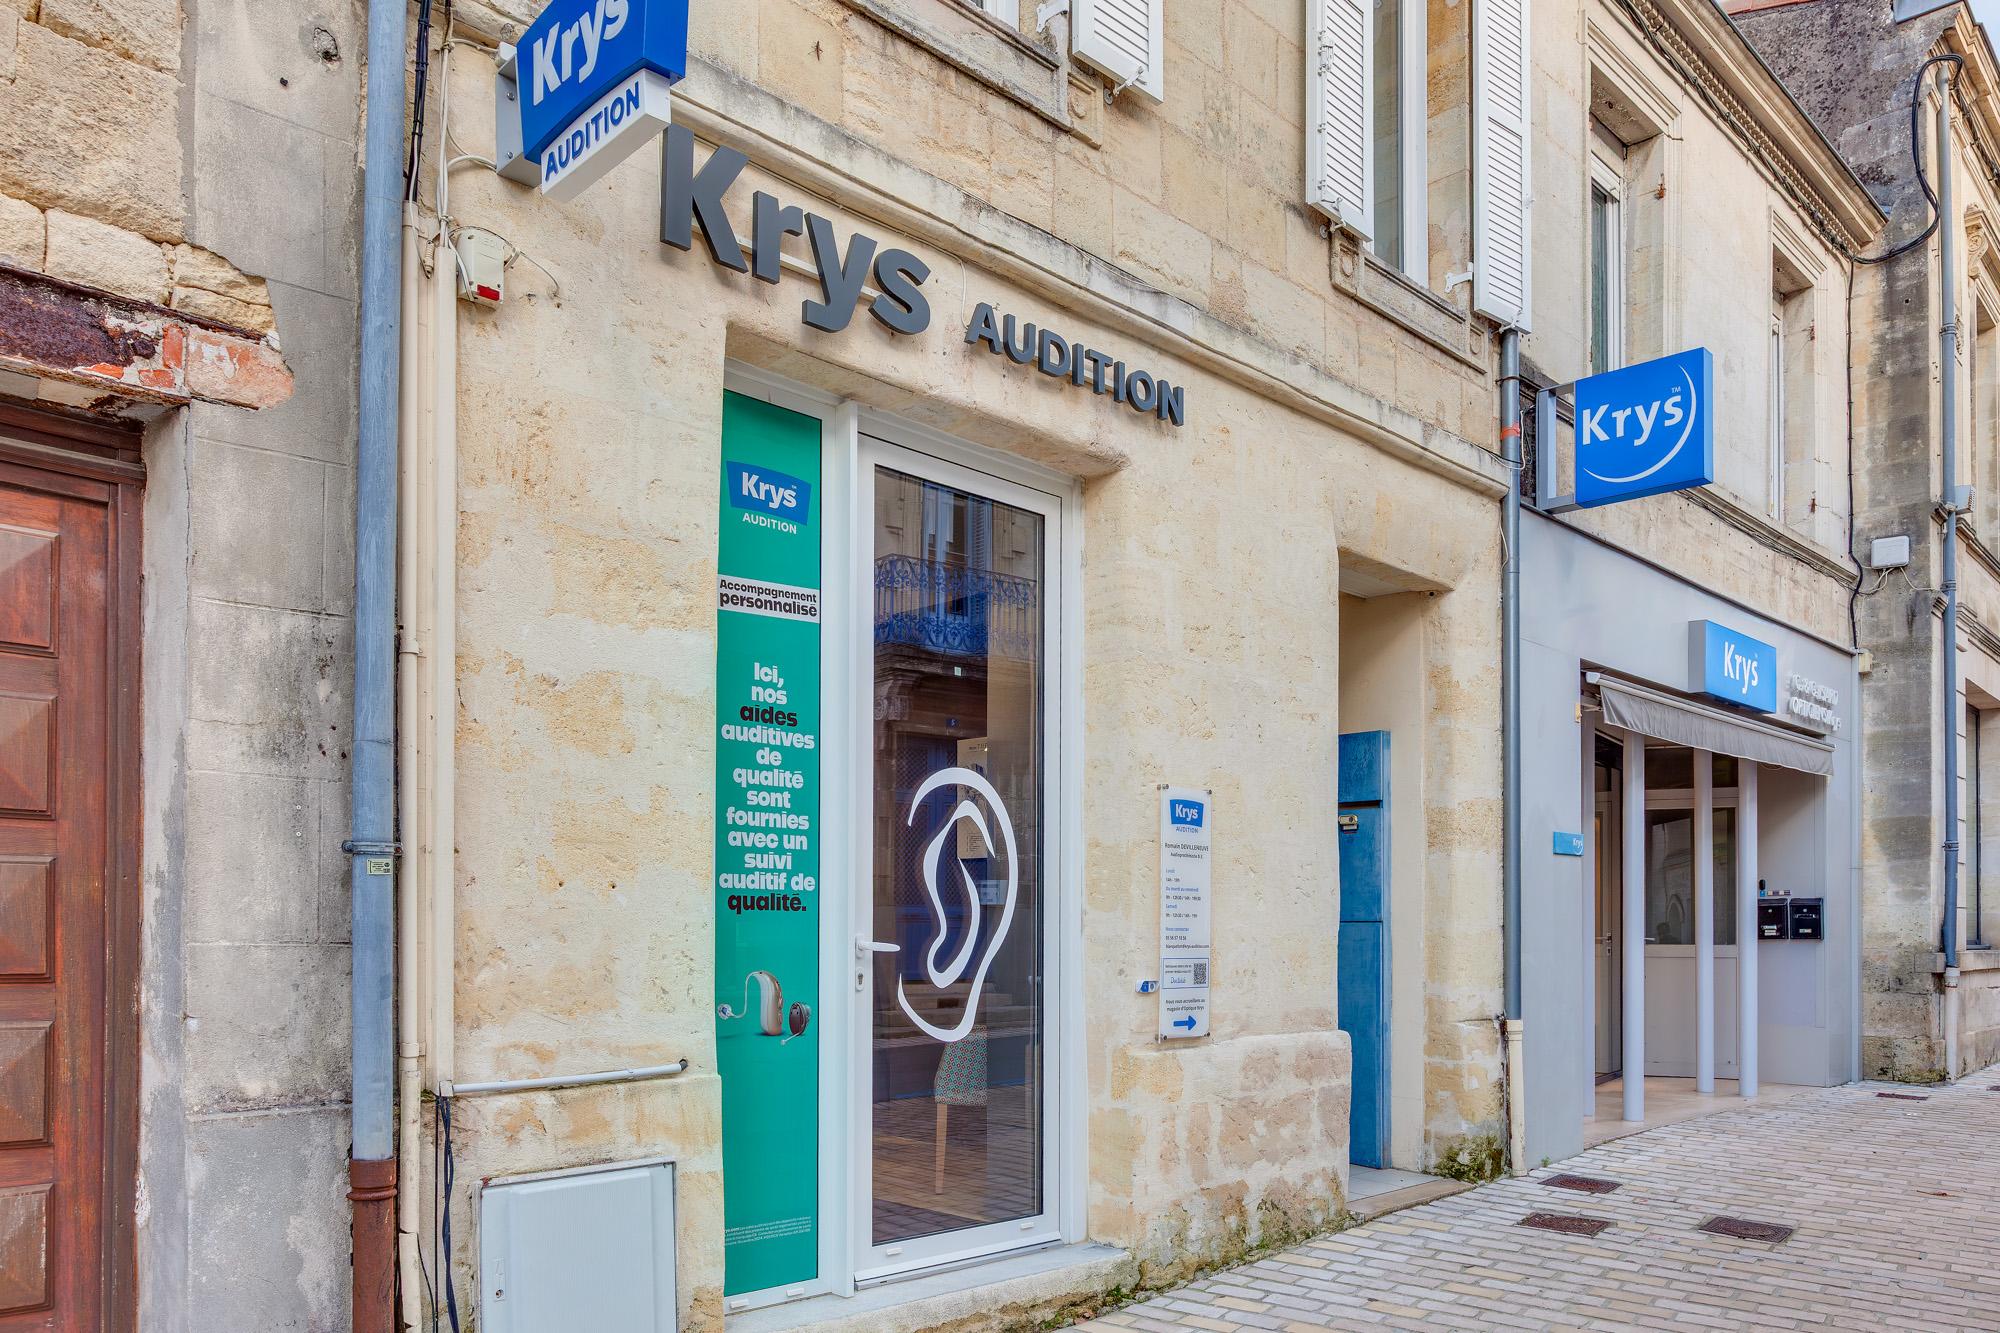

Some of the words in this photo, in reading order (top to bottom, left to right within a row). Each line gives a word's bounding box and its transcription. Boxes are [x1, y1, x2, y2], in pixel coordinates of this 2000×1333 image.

[533, 0, 629, 106] Krys
[545, 81, 640, 182] AUDITION
[659, 124, 931, 334] Krys
[964, 302, 1185, 427] AUDITION
[1581, 391, 1684, 446] Krys
[742, 471, 797, 509] Krys
[742, 512, 797, 535] AUDITION
[719, 579, 817, 604] Accompagnement
[719, 592, 818, 617] personnalisé
[754, 662, 784, 688] Ici,
[1724, 641, 1759, 694] Krys
[751, 685, 787, 705] nos
[740, 705, 798, 727] aides
[721, 724, 815, 749] auditives
[756, 747, 782, 766] de
[733, 767, 804, 789] qualité
[746, 790, 791, 809] sont
[726, 806, 810, 830] fournies
[1175, 803, 1199, 822] Krys
[727, 831, 779, 848] avec
[783, 834, 808, 850] un
[1175, 826, 1199, 834] AUDITION
[744, 852, 792, 870] suivi
[719, 871, 787, 890] auditif
[790, 873, 816, 891] de
[727, 893, 807, 915] qualité.
